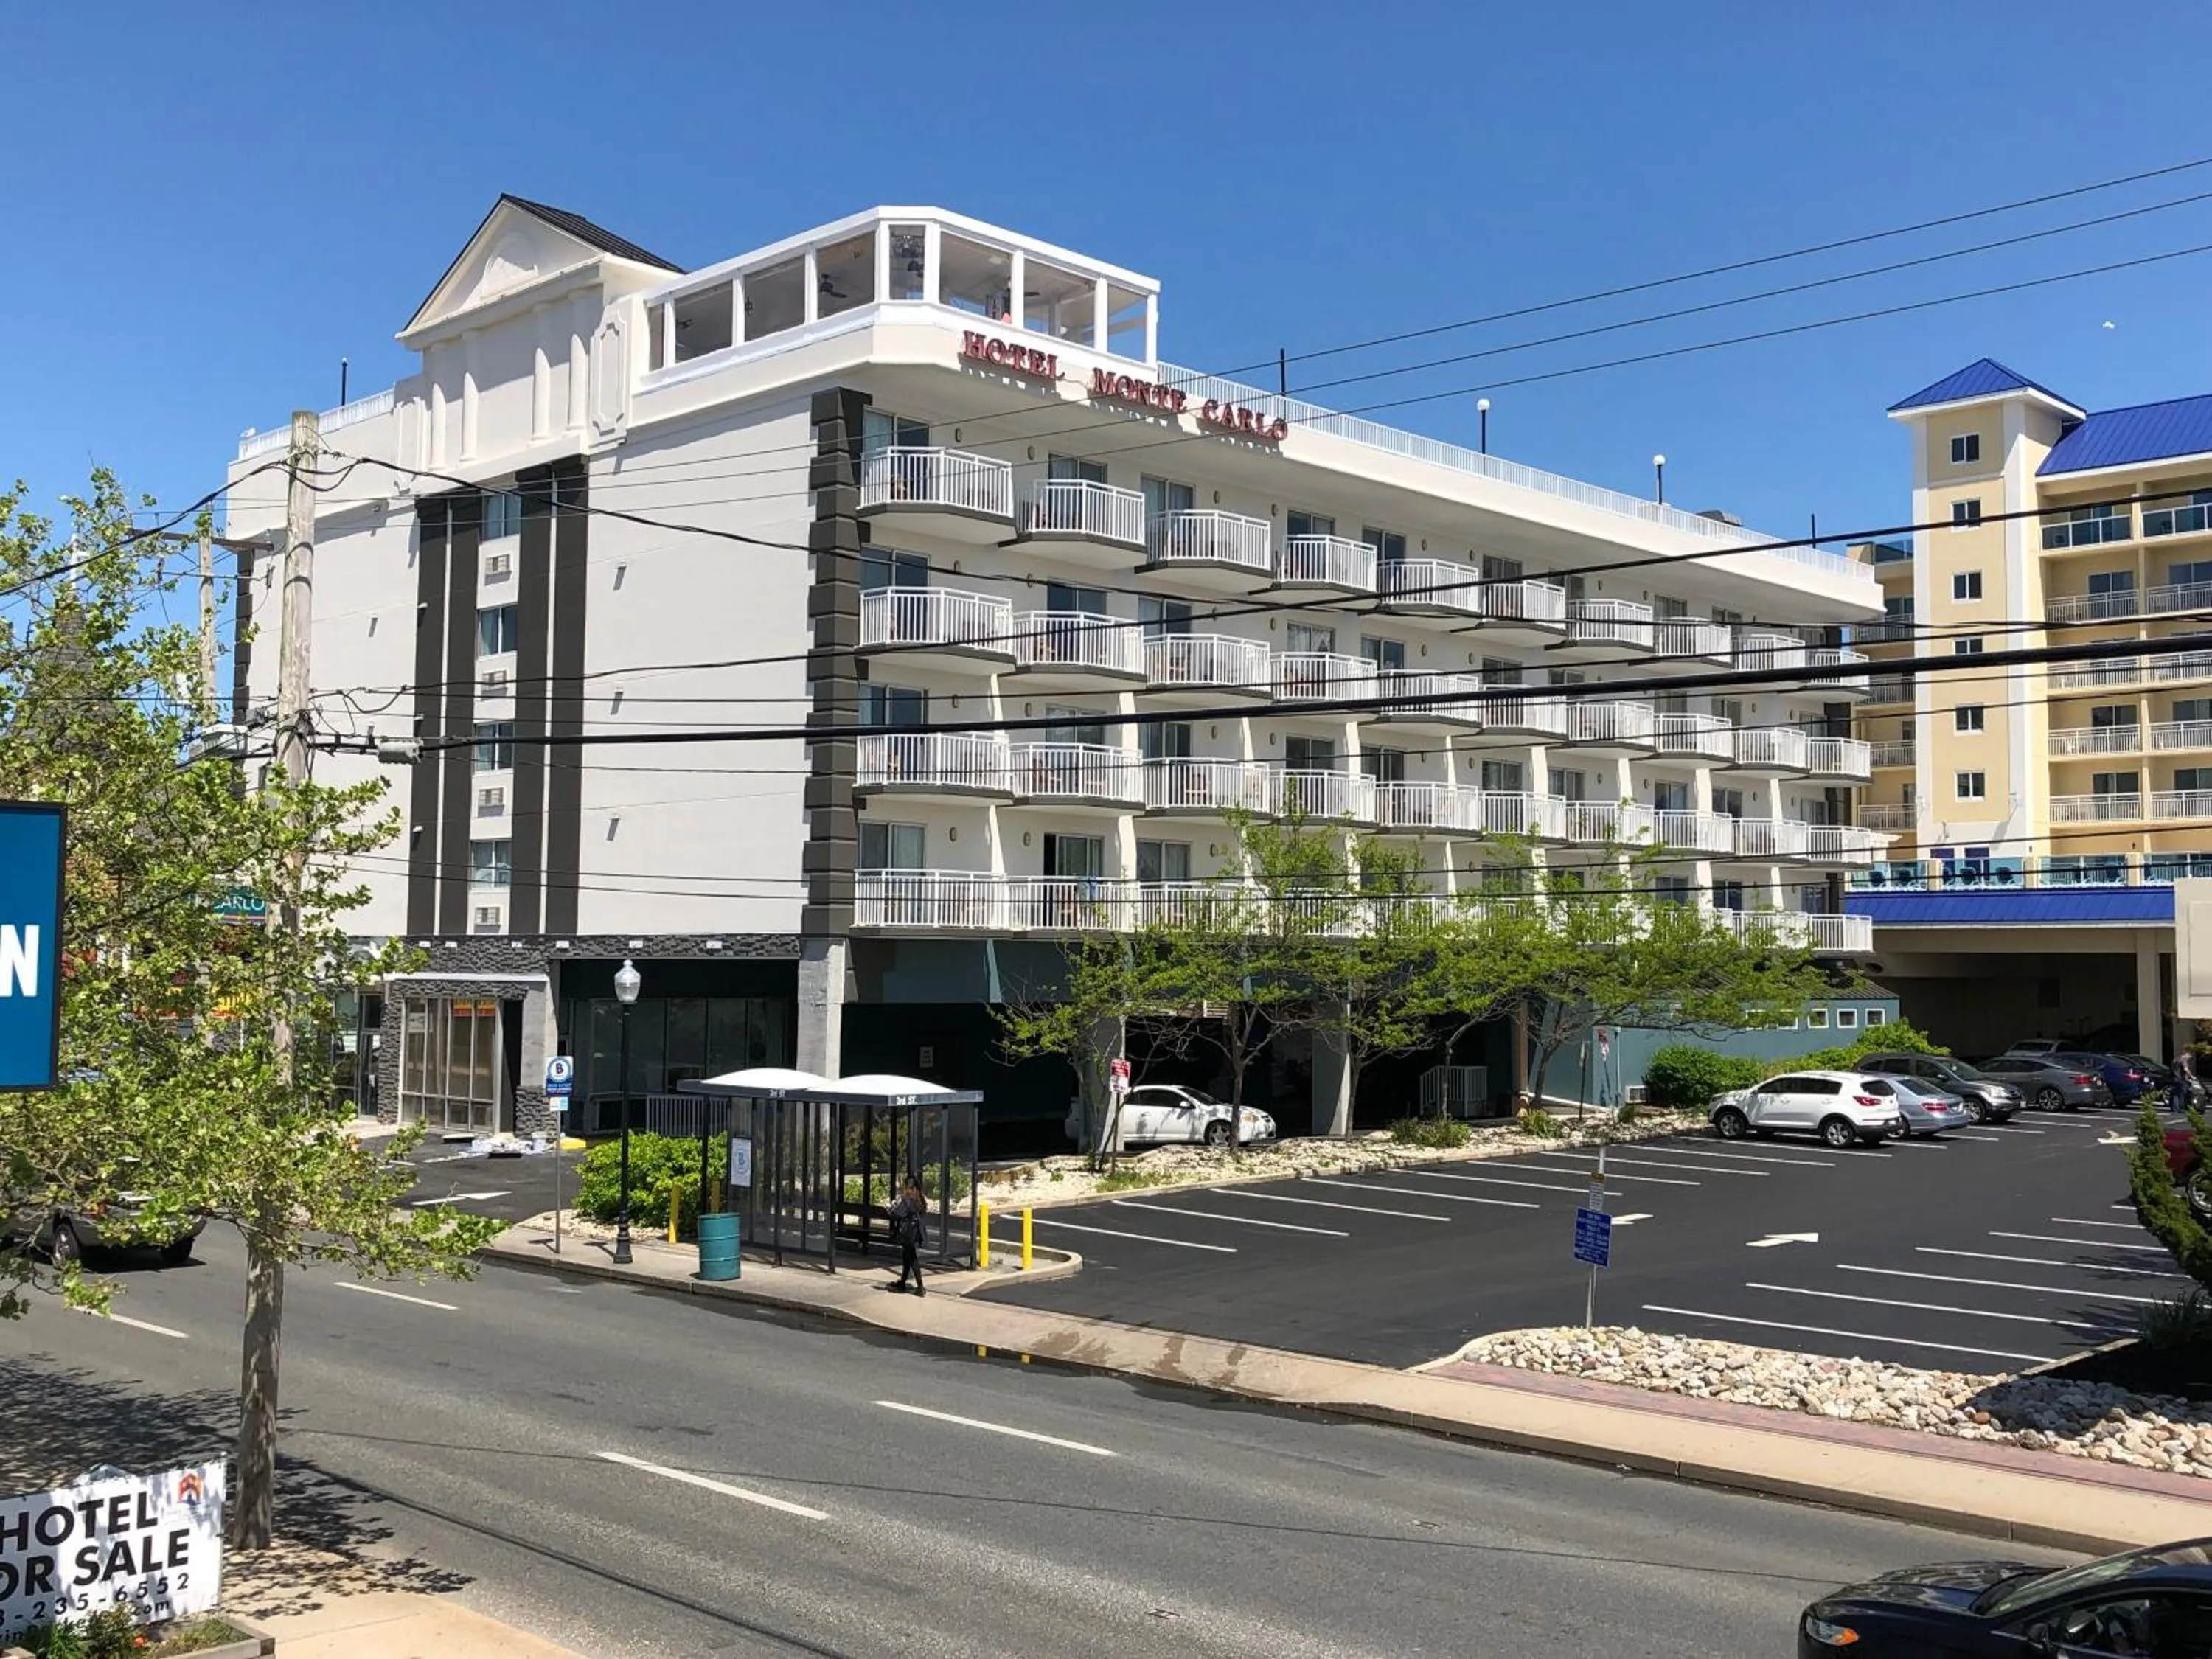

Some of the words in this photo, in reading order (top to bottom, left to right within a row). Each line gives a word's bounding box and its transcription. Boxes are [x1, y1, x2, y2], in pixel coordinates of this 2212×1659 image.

[964, 330, 1065, 380] HOTEL
[1093, 367, 1188, 414] MONTE
[1202, 399, 1289, 442] CARLO
[0, 1491, 158, 1554] HOTEL
[74, 1528, 189, 1586] SALE
